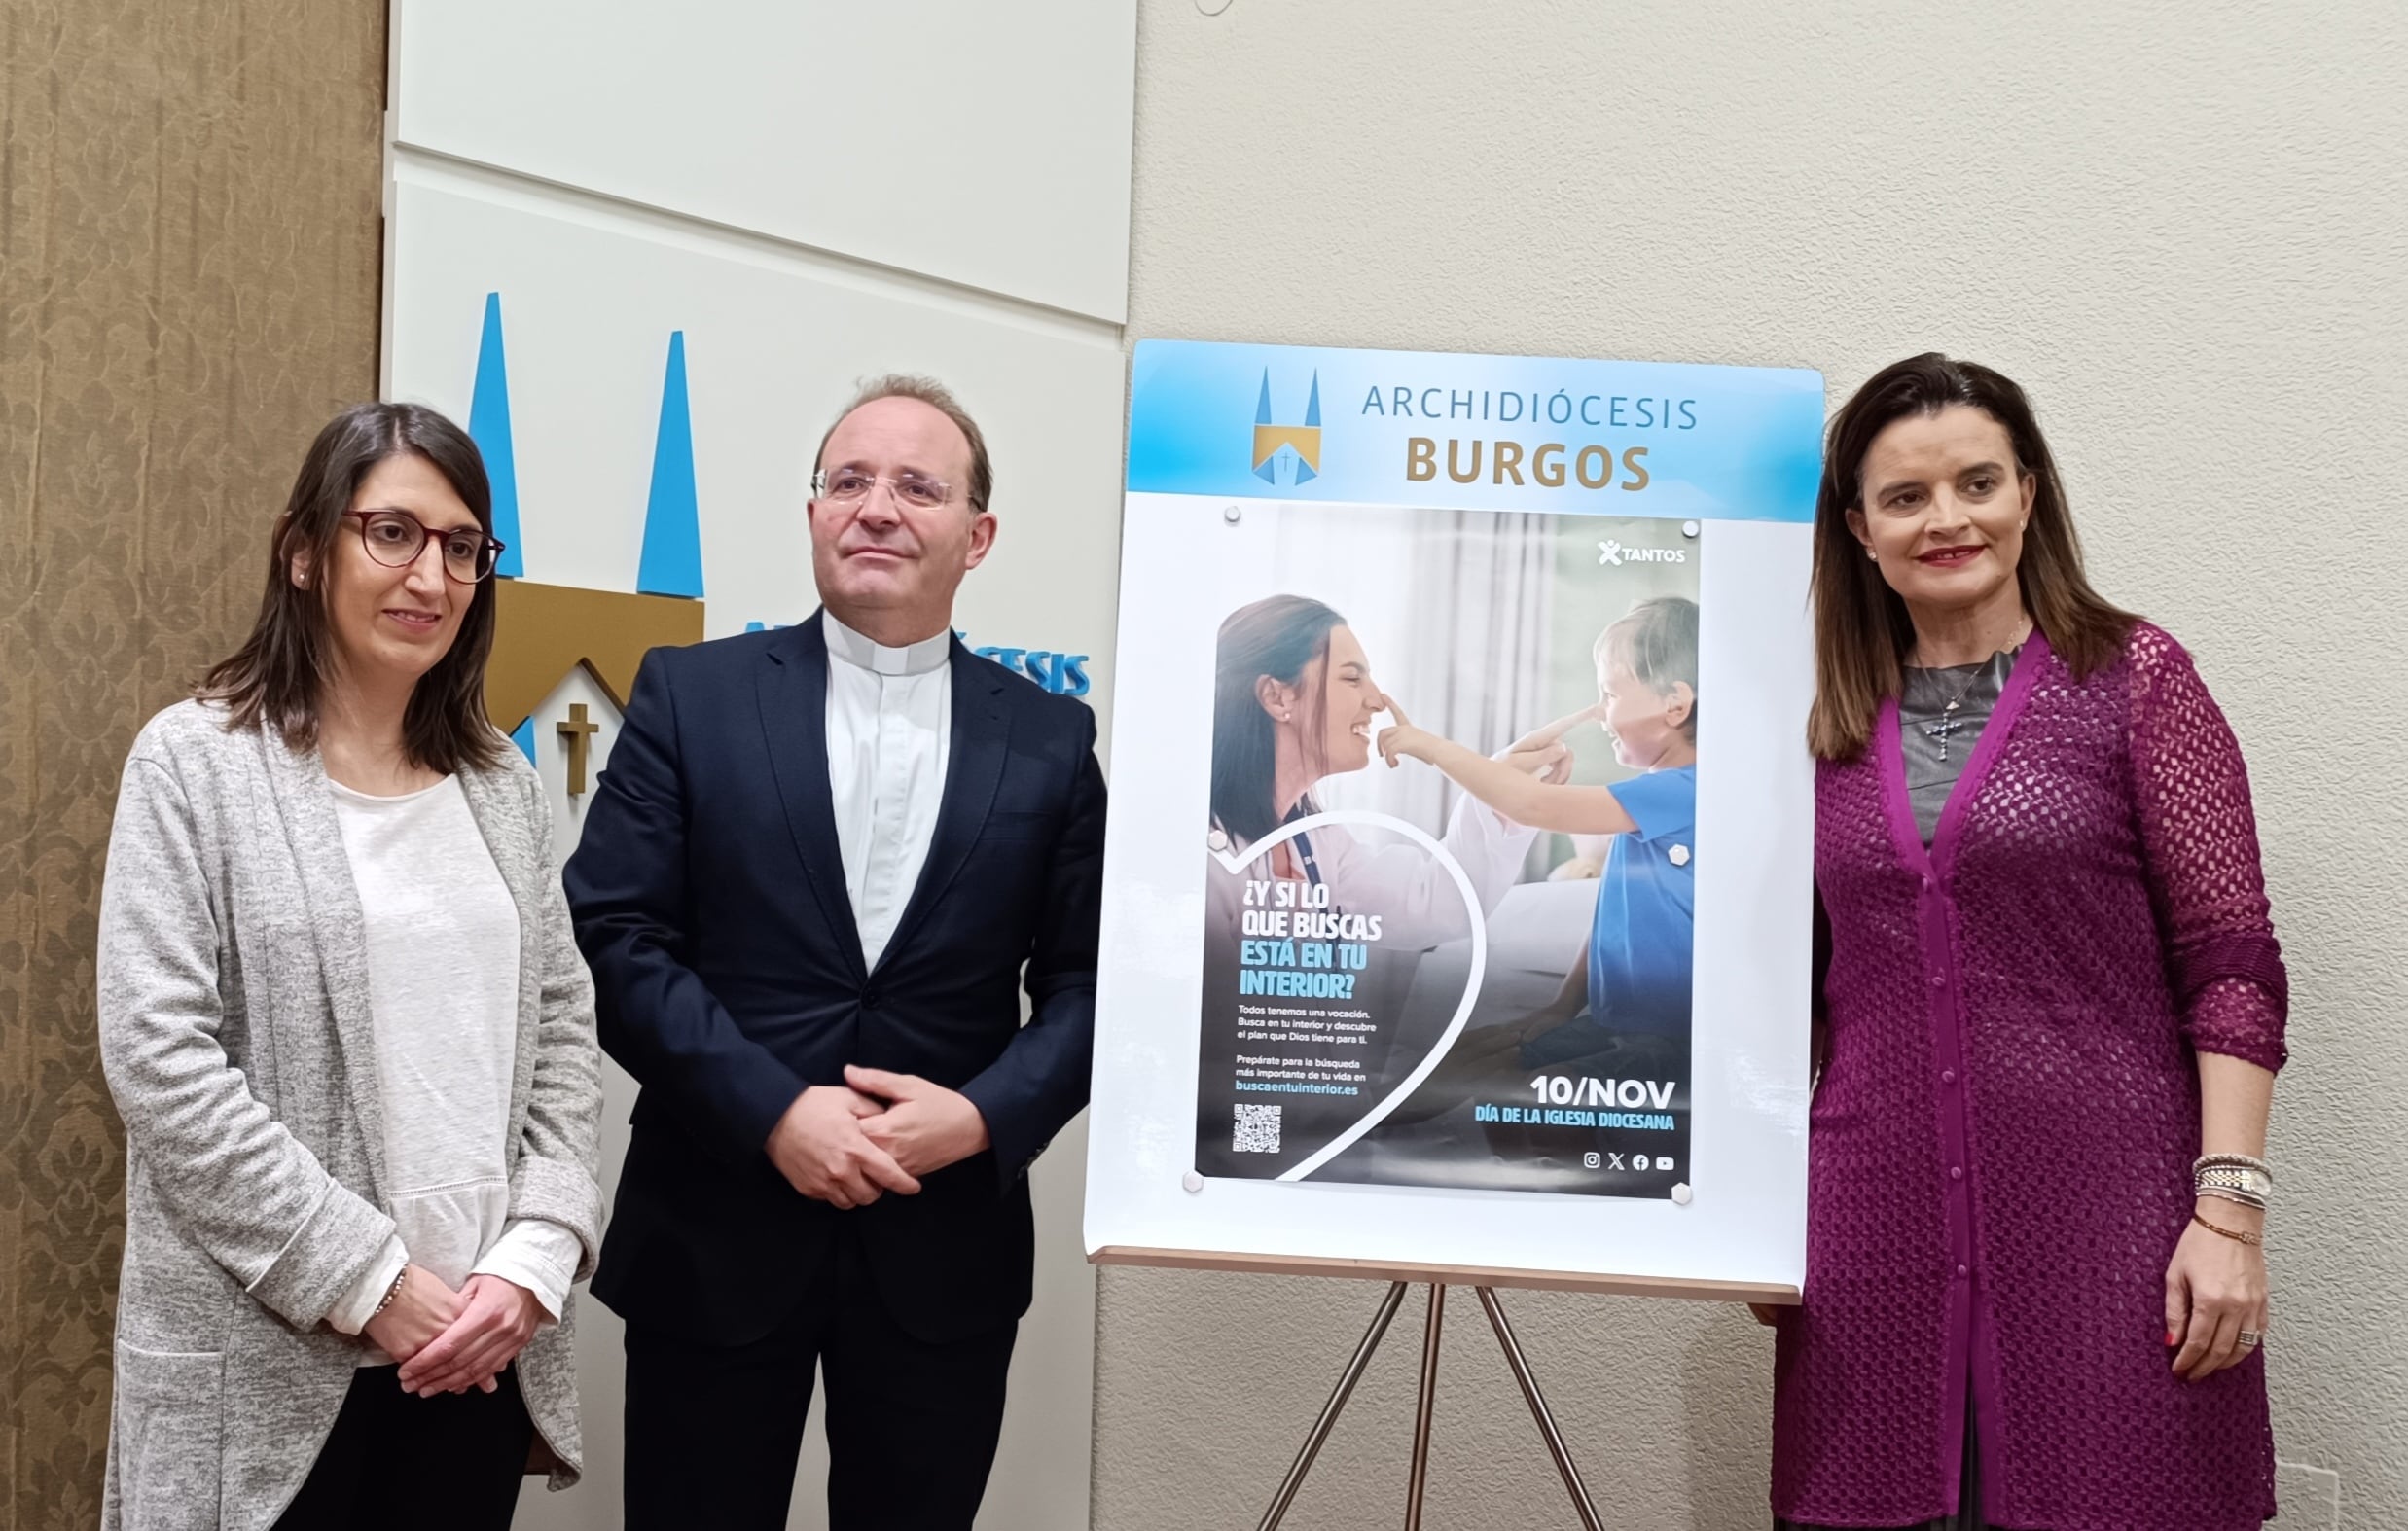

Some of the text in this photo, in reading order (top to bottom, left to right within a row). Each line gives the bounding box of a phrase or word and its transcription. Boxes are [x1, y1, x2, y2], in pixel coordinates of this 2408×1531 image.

[1362, 385, 1697, 430] ARCHIDIÓCESIS
[1406, 437, 1650, 492] BURGOS
[1243, 880, 1329, 908] ¿Y SI LO
[1242, 910, 1383, 941] QUE BUSCAS
[1240, 937, 1367, 970] ESTÁ EN TU
[1240, 970, 1355, 999] INTERIOR?
[1238, 1004, 1265, 1015] Todos
[1268, 1007, 1306, 1016] tenemos
[1327, 1009, 1370, 1019] vocación.
[1238, 1017, 1265, 1027] Busca
[1281, 1019, 1290, 1028] tu
[1292, 1019, 1325, 1029] interior
[1326, 1022, 1333, 1032] y
[1334, 1021, 1377, 1032] descubre
[1237, 1030, 1368, 1045] el plan que Dios tiene para ti.
[1236, 1054, 1360, 1069] Prepárate para la búsqueda
[1236, 1068, 1255, 1077] más
[1256, 1068, 1306, 1079] importante
[1308, 1070, 1319, 1080] de
[1321, 1071, 1331, 1081] tu
[1333, 1072, 1352, 1081] vida
[1235, 1080, 1358, 1095] buscaentuinterior.es
[1529, 1075, 1676, 1110] 10/NOV
[1475, 1103, 1674, 1130] DÍA DE LA IGLESIA DIOCESANA
